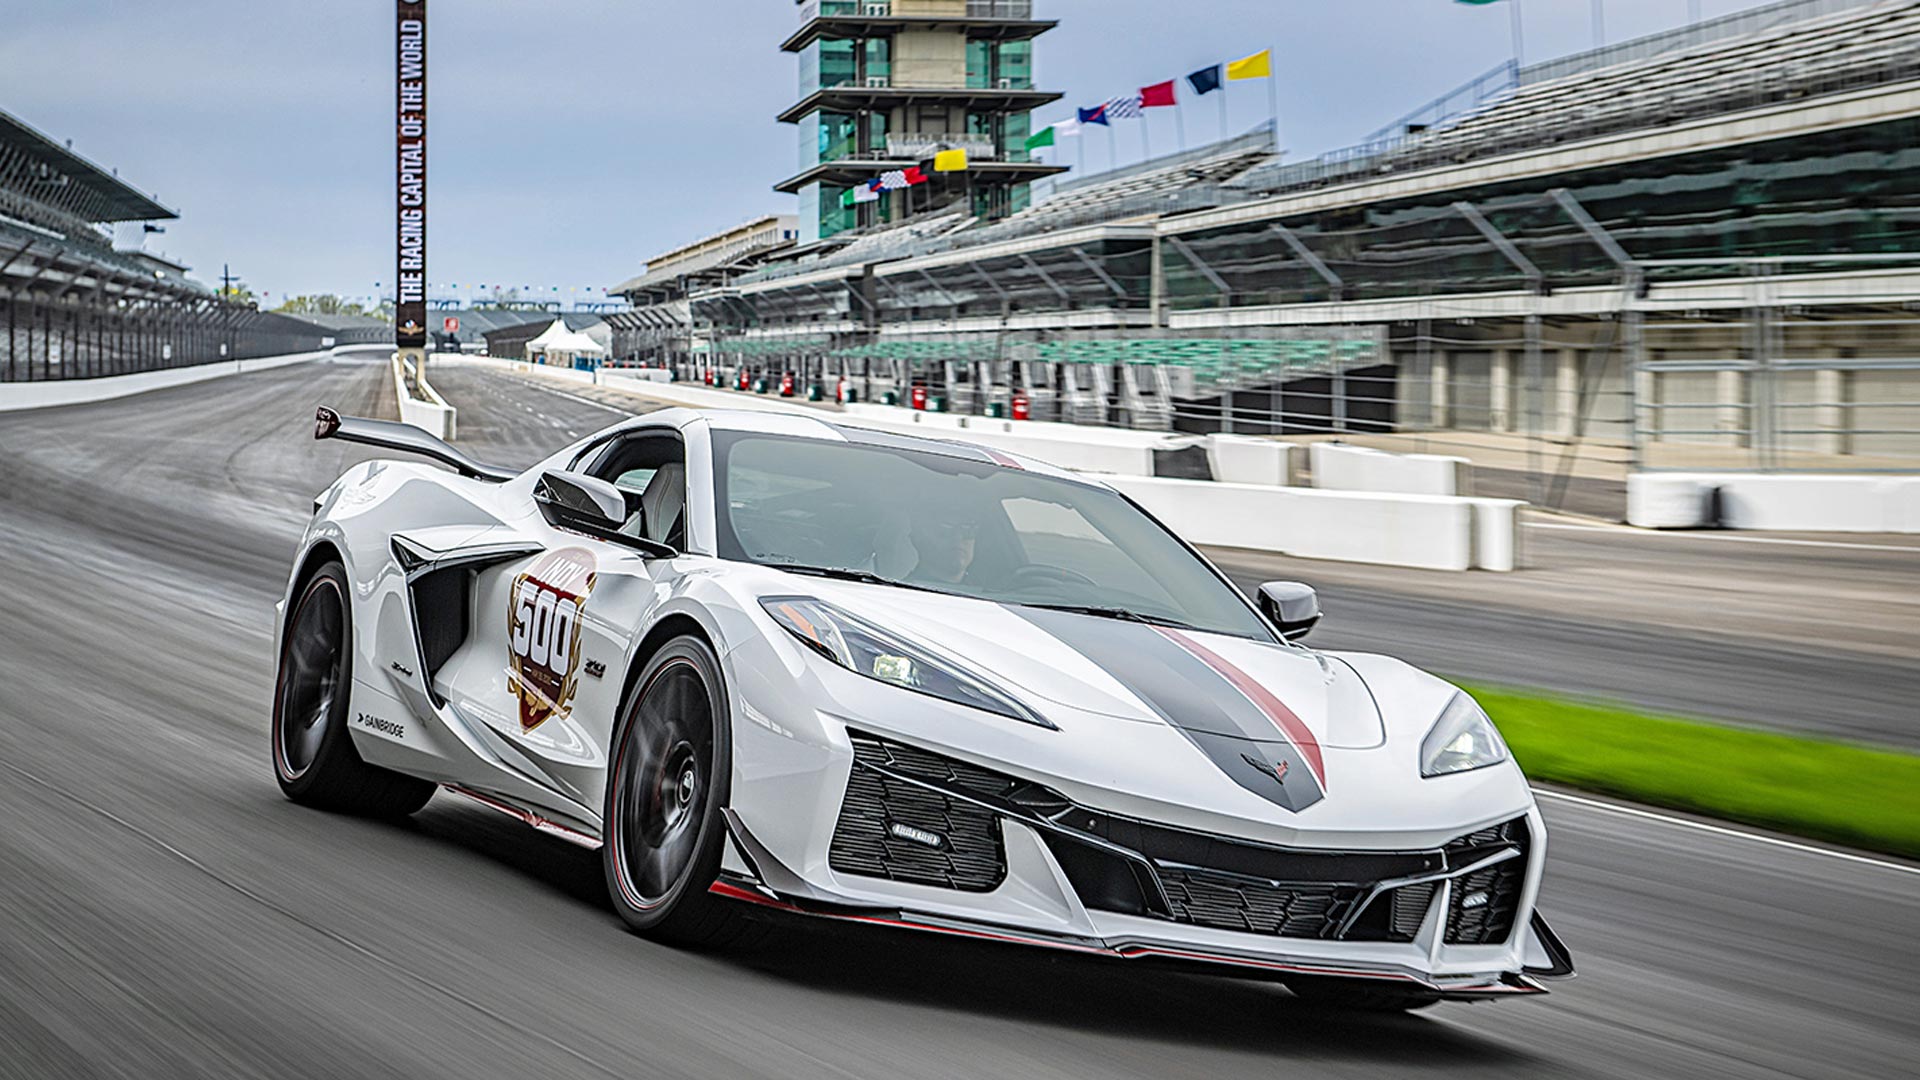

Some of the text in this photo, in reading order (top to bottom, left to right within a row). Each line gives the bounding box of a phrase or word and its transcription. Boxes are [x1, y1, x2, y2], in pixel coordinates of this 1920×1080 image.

[401, 19, 423, 304] THE RACING CAPITAL OF THE WORLD
[536, 556, 588, 591] INDY
[513, 580, 577, 676] 500
[364, 714, 405, 738] GAINBRIDGE
